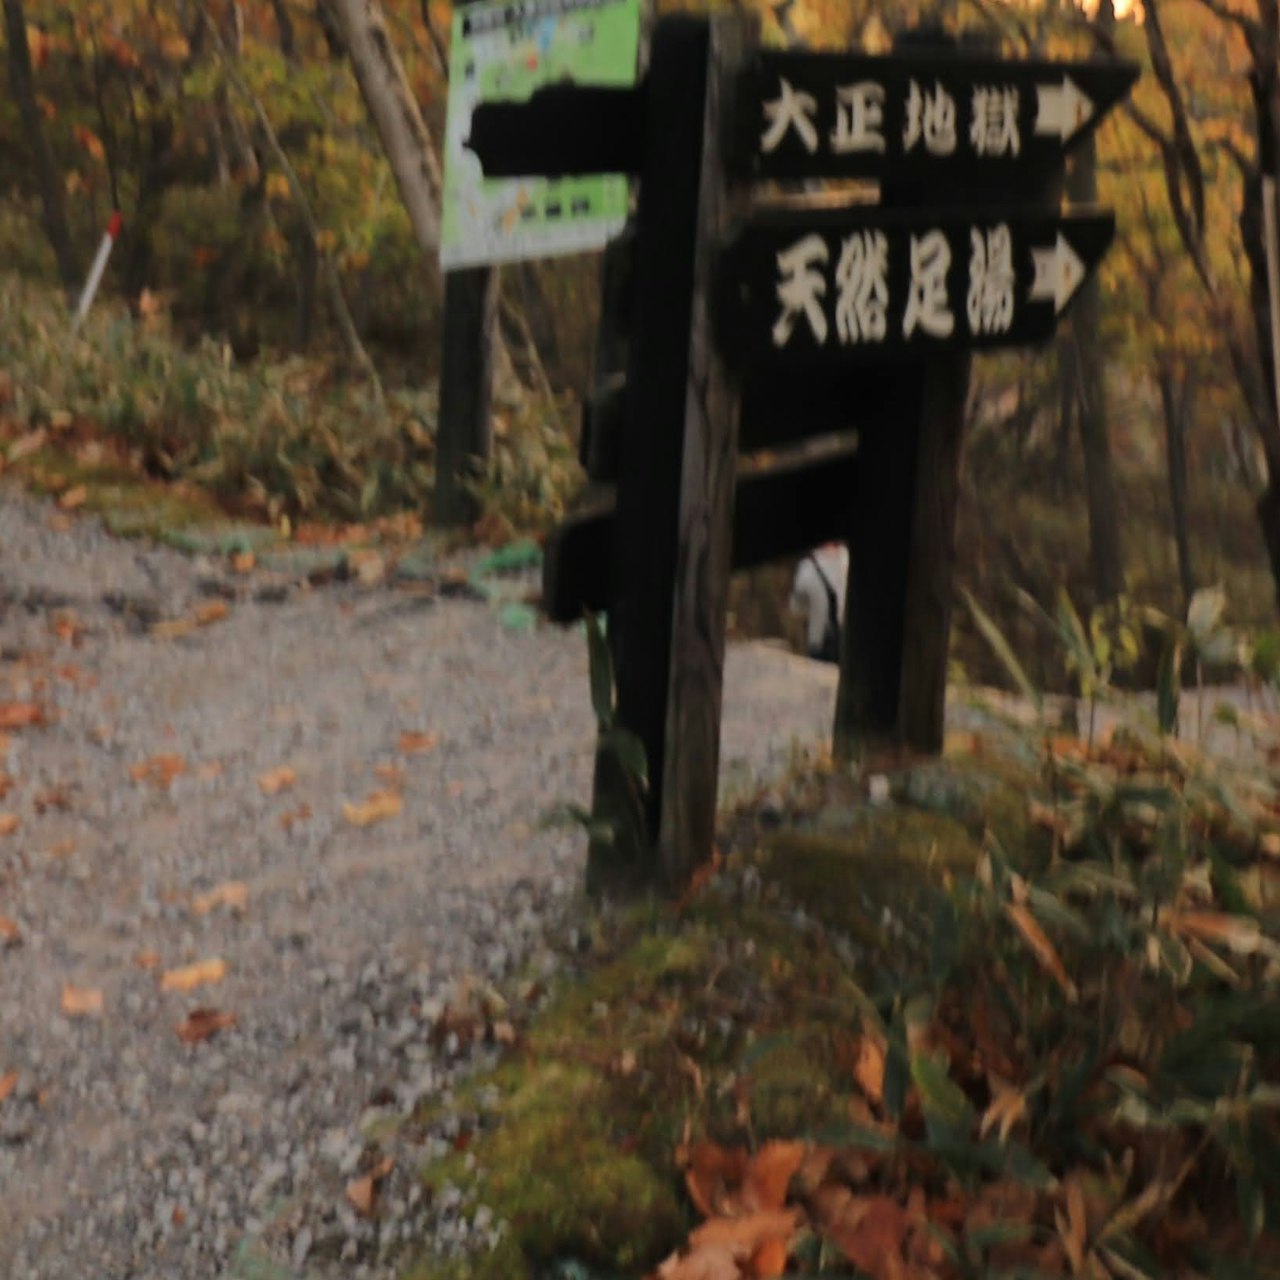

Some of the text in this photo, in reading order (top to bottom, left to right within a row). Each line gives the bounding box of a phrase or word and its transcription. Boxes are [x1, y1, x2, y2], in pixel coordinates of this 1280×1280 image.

[761, 78, 1020, 157] 大正地獄
[772, 223, 1015, 346] 天然足湯
